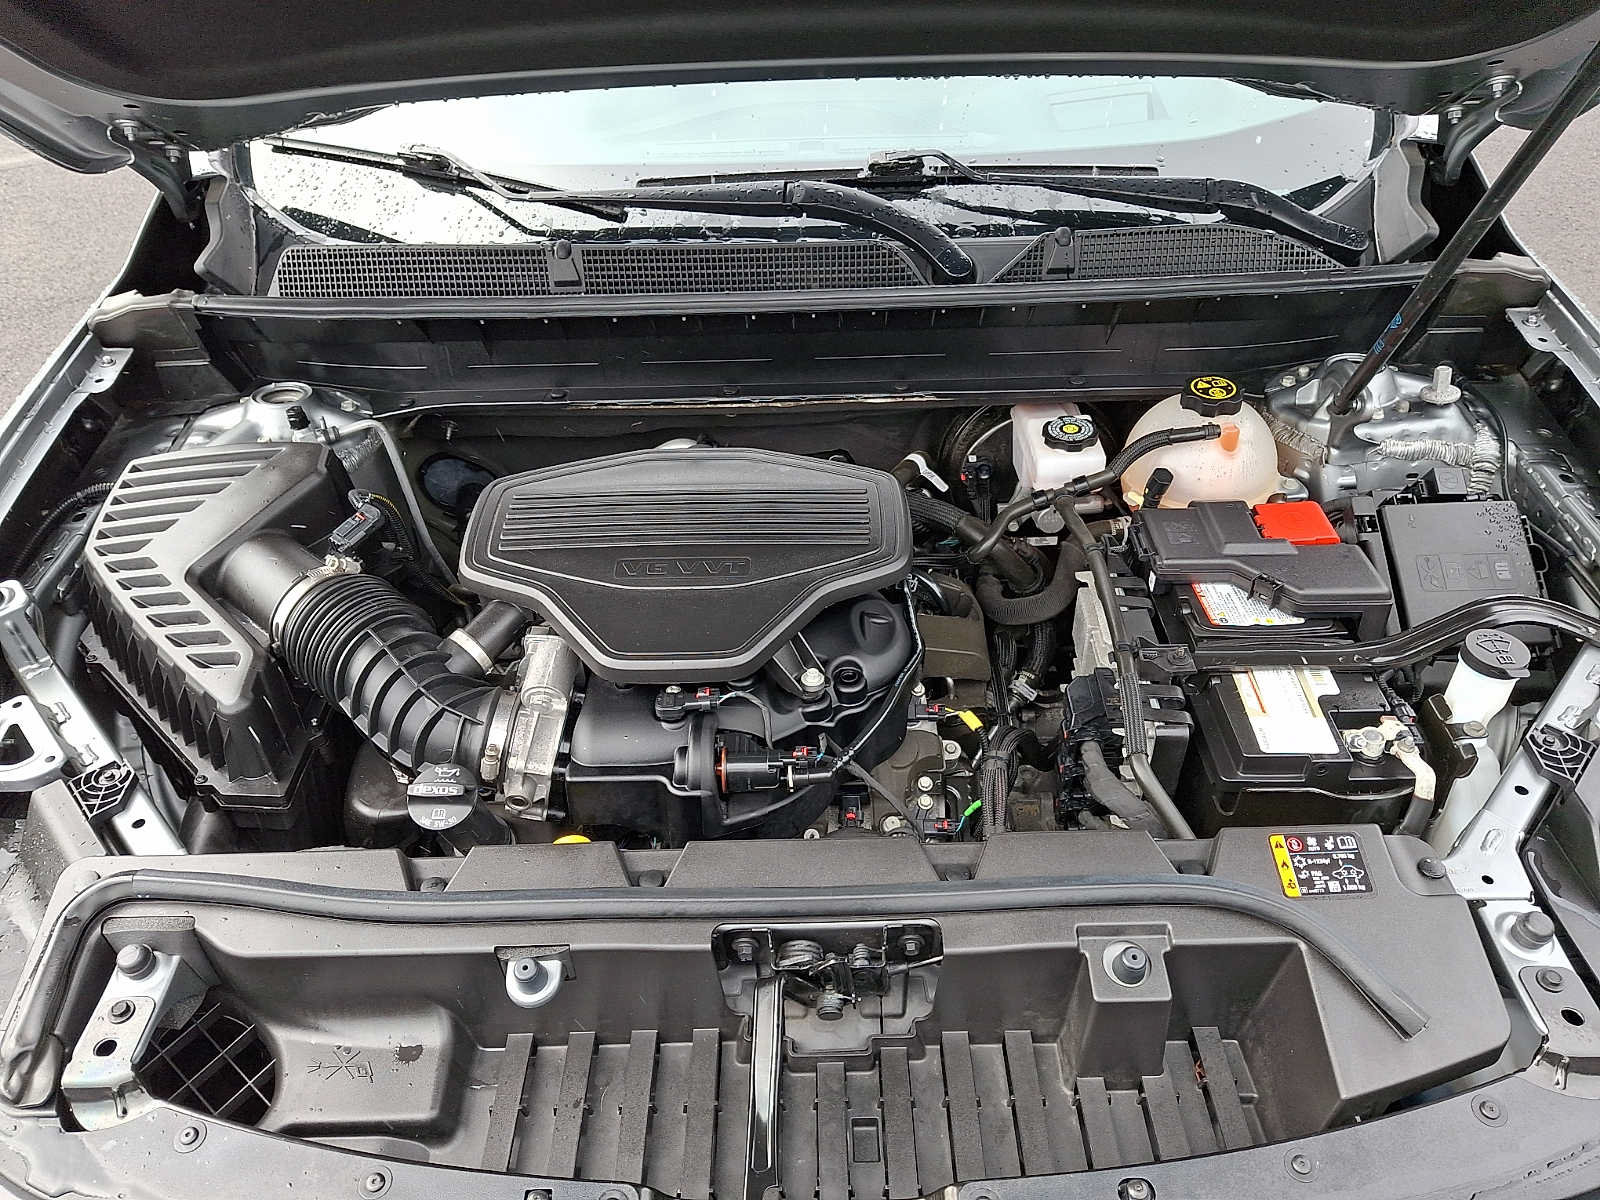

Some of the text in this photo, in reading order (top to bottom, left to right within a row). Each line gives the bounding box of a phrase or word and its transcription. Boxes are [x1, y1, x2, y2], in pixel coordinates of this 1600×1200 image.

[622, 560, 746, 576] V6 VVT
[413, 784, 458, 795] dexos
[421, 816, 432, 826] SAE
